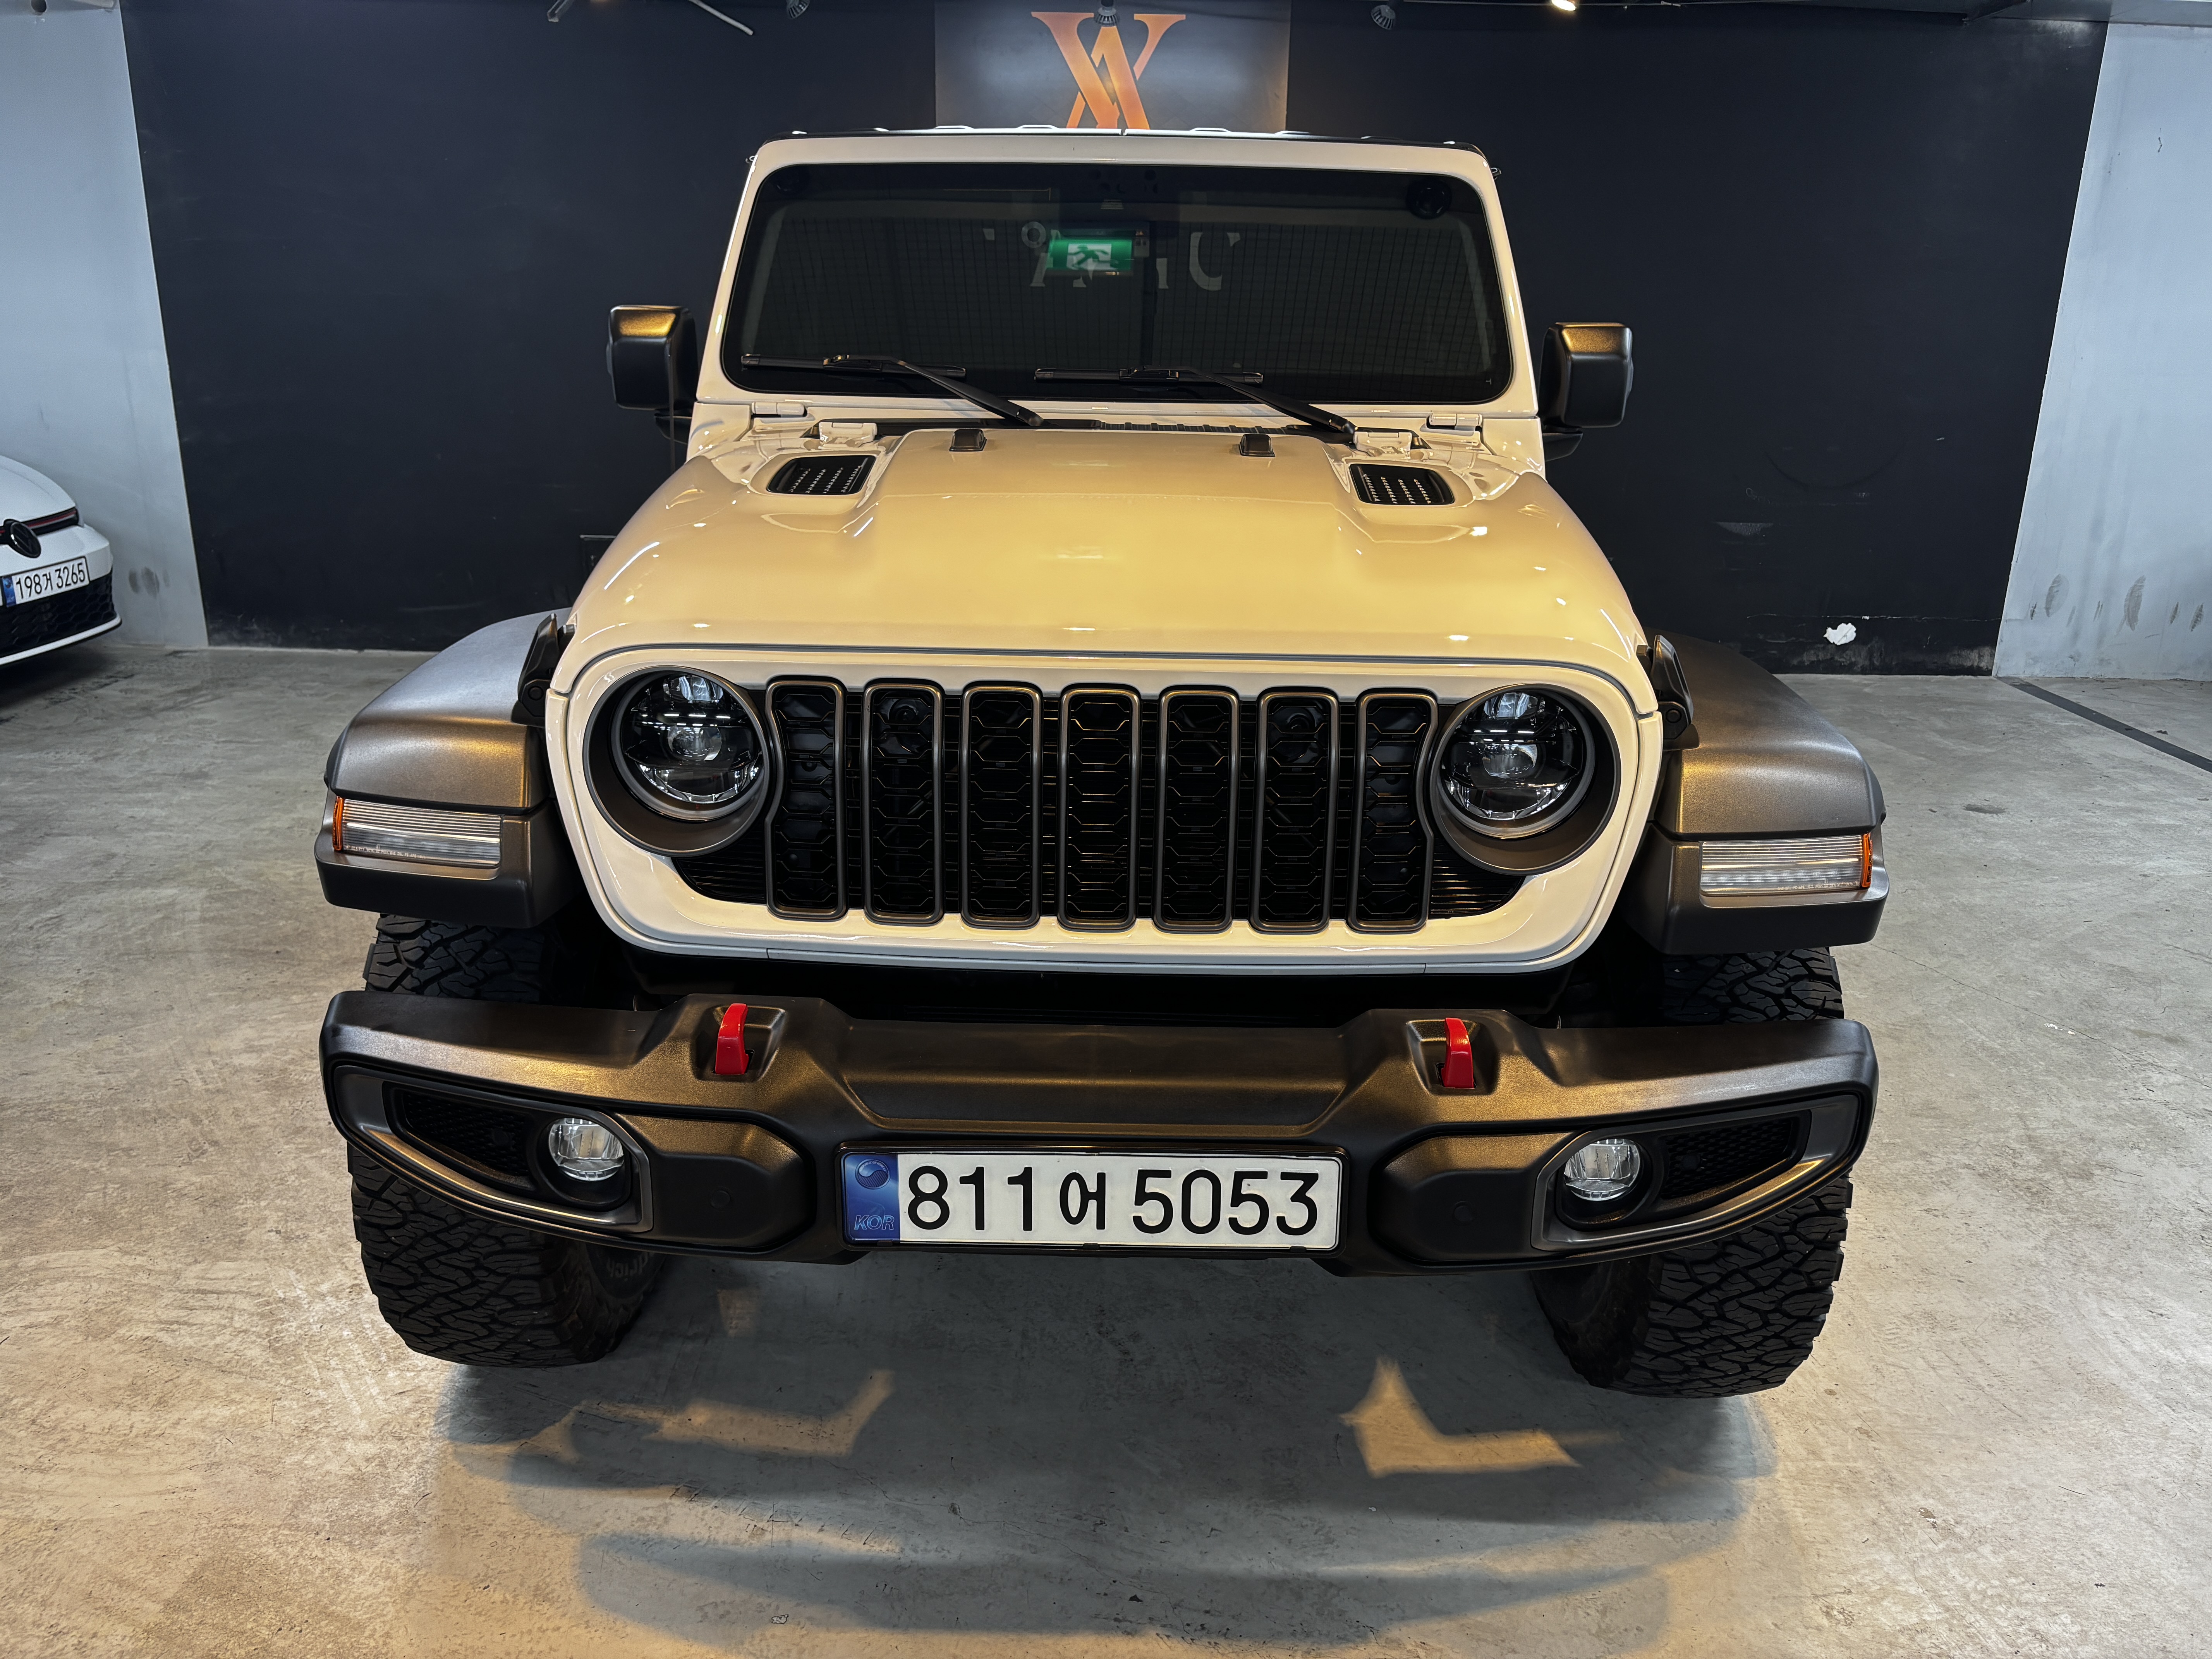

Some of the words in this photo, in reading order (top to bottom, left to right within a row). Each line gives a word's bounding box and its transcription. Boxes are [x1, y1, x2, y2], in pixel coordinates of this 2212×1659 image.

[55, 562, 85, 589] 3265
[908, 1166, 1106, 1231] 811어
[1133, 1169, 1319, 1236] 5053
[854, 1215, 895, 1230] KOR
